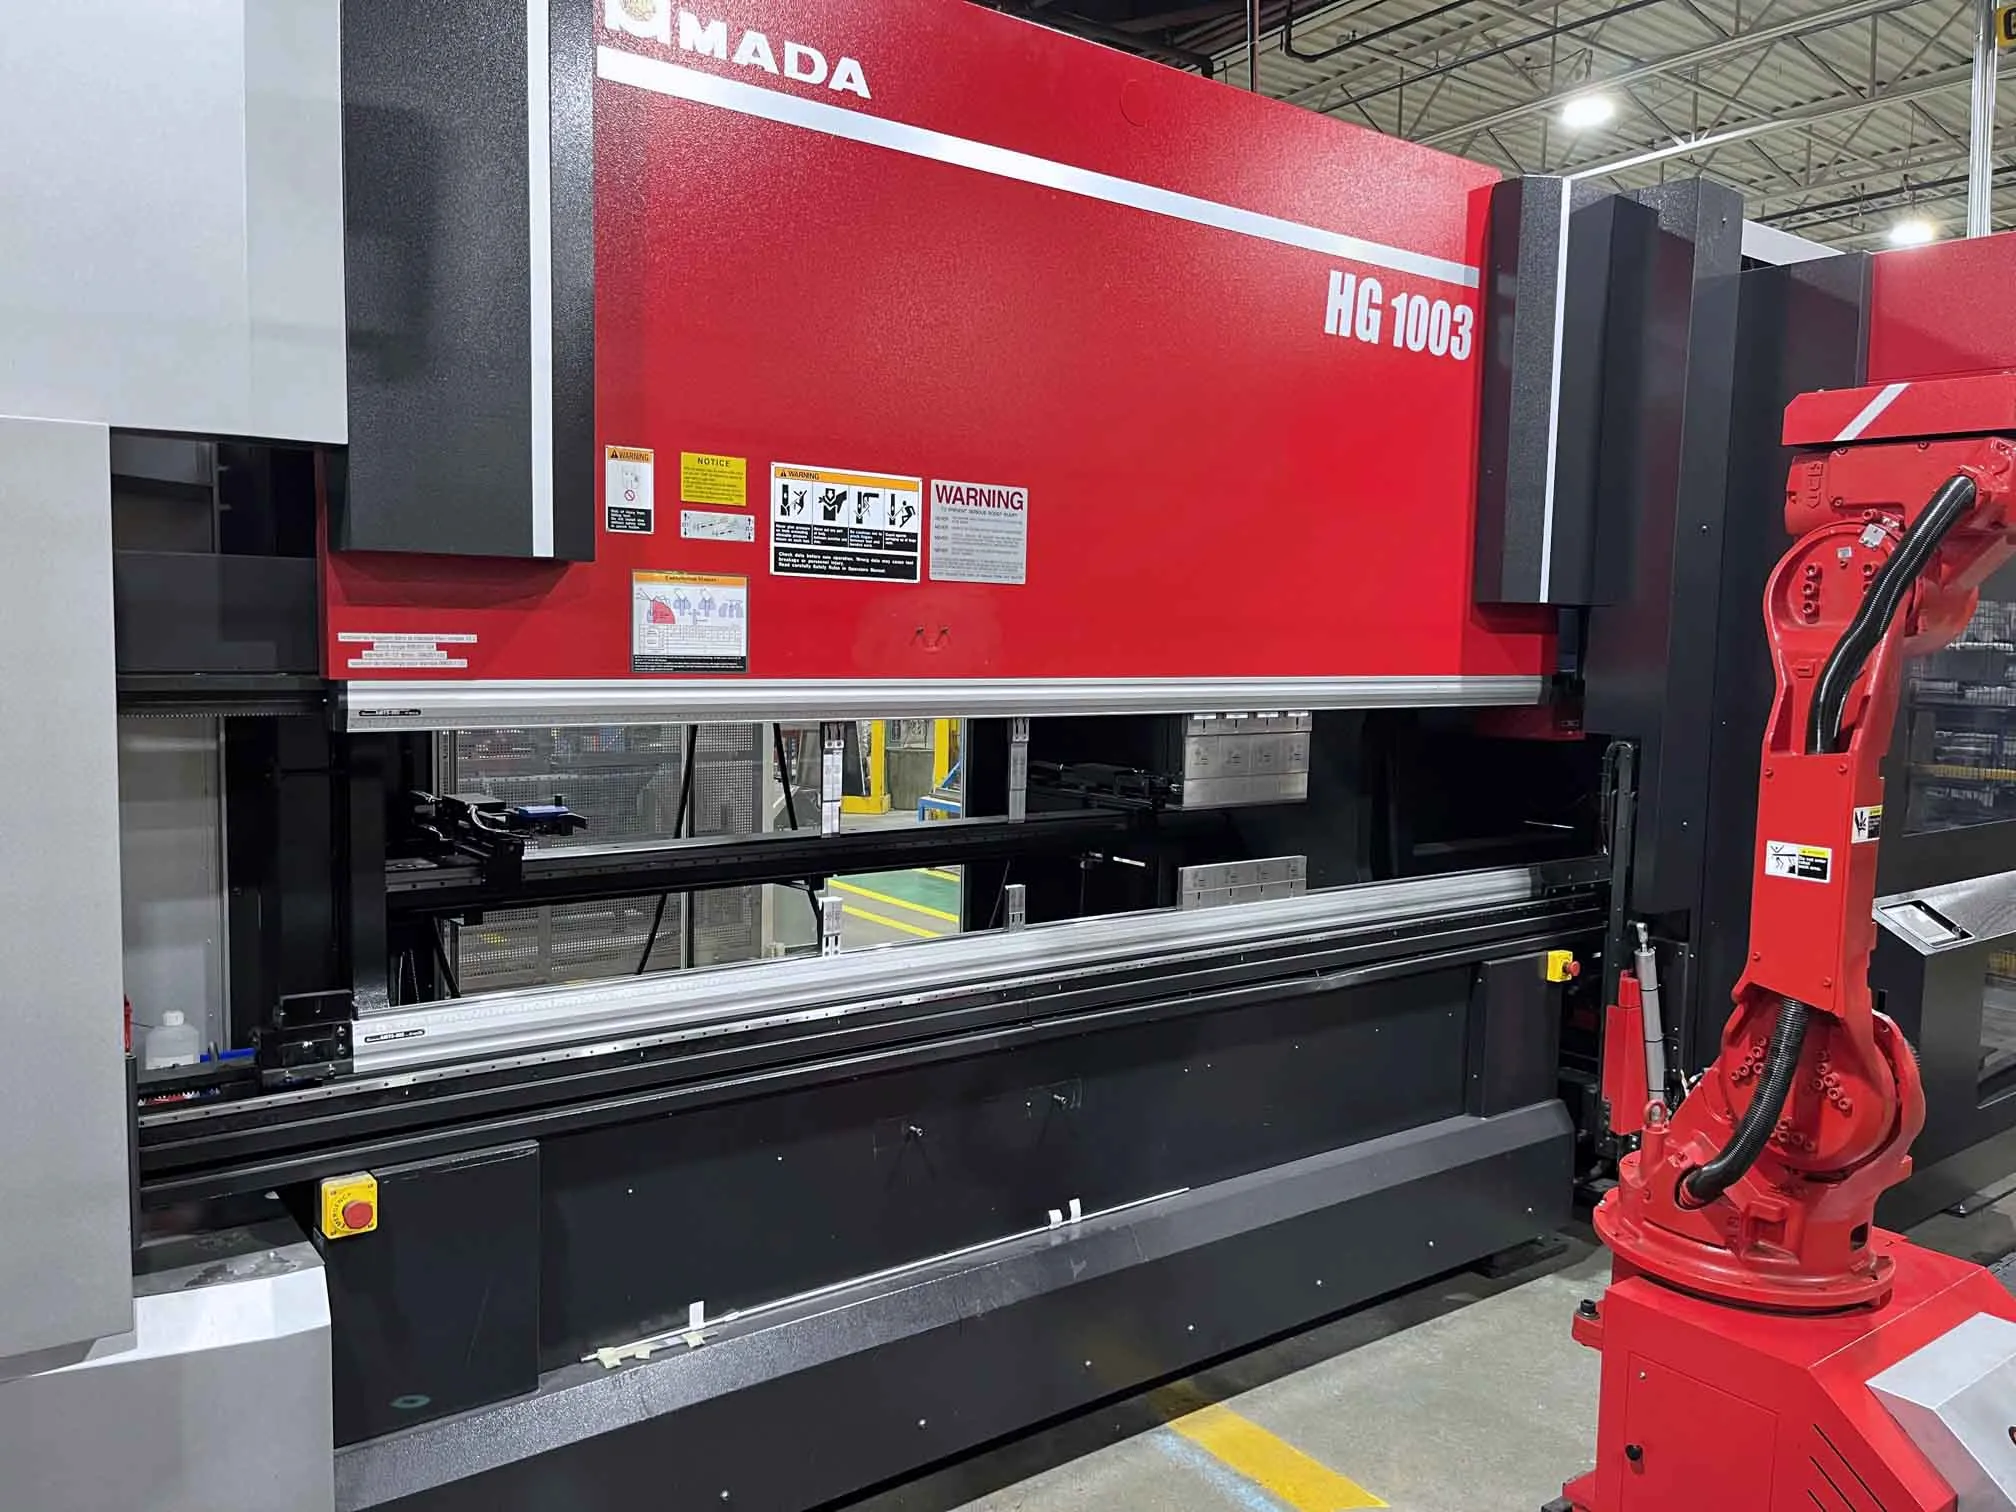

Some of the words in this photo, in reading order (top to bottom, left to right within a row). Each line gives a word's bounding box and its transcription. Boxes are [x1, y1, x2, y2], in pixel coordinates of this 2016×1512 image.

[1324, 269, 1383, 344] HG
[1391, 292, 1474, 360] 1003
[619, 451, 649, 462] WARNING
[697, 457, 729, 467] NOTICE
[789, 471, 820, 480] WARNING
[935, 484, 1023, 511] WARNING
